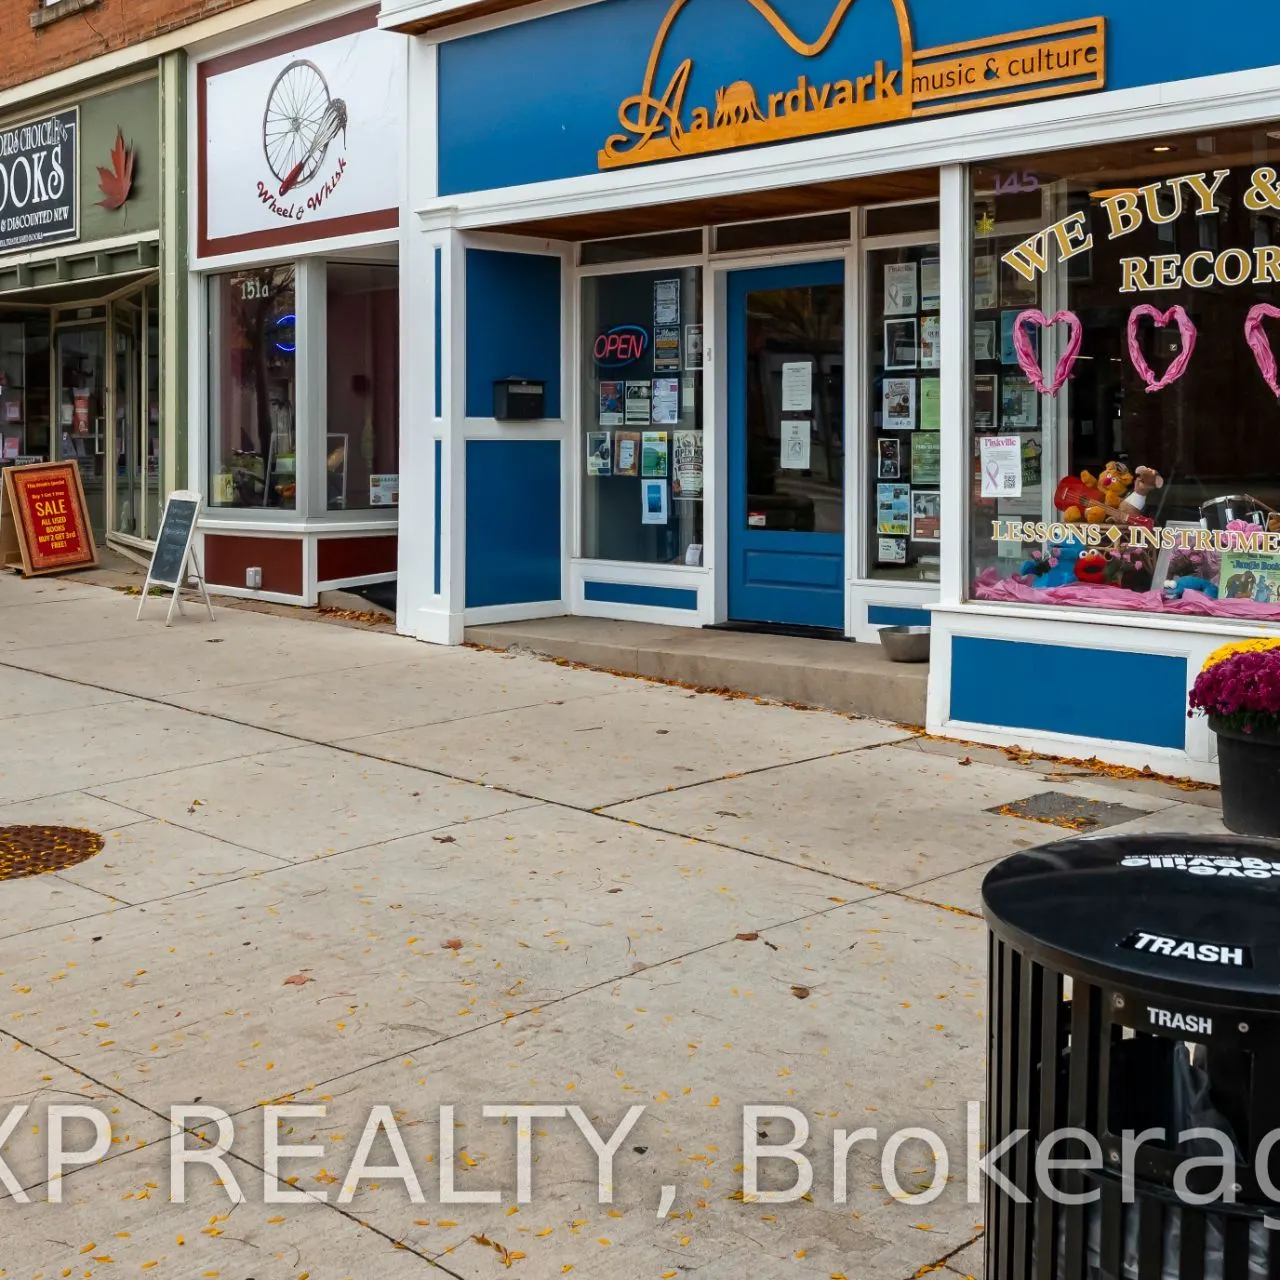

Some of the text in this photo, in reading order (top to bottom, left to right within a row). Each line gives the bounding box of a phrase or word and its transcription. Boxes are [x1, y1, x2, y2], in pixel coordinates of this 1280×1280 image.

[912, 62, 976, 94] music
[982, 57, 1001, 80] &
[1008, 43, 1099, 77] culture
[20, 121, 52, 151] CHOICE
[257, 157, 347, 220] Wheel & Whisk
[994, 174, 1039, 195] 145
[7, 209, 53, 232] DISCOUNTED
[53, 206, 70, 221] NEW
[1001, 211, 1094, 283] WE
[1101, 168, 1230, 240] BUY
[241, 281, 269, 300] 151a
[594, 334, 644, 359] OPEN
[675, 448, 692, 458] OPEN
[984, 438, 1017, 447] Pinkville
[35, 499, 68, 518] SALE
[41, 516, 67, 526] ALL USED
[45, 525, 65, 533] BOOKS
[38, 531, 76, 543] BUY 2 GET 3rd
[992, 520, 1102, 546] LESSONS
[51, 541, 67, 550] FREE!
[1261, 561, 1280, 571] Book
[1133, 932, 1243, 966] TRASH
[1147, 1006, 1213, 1035] TRASH
